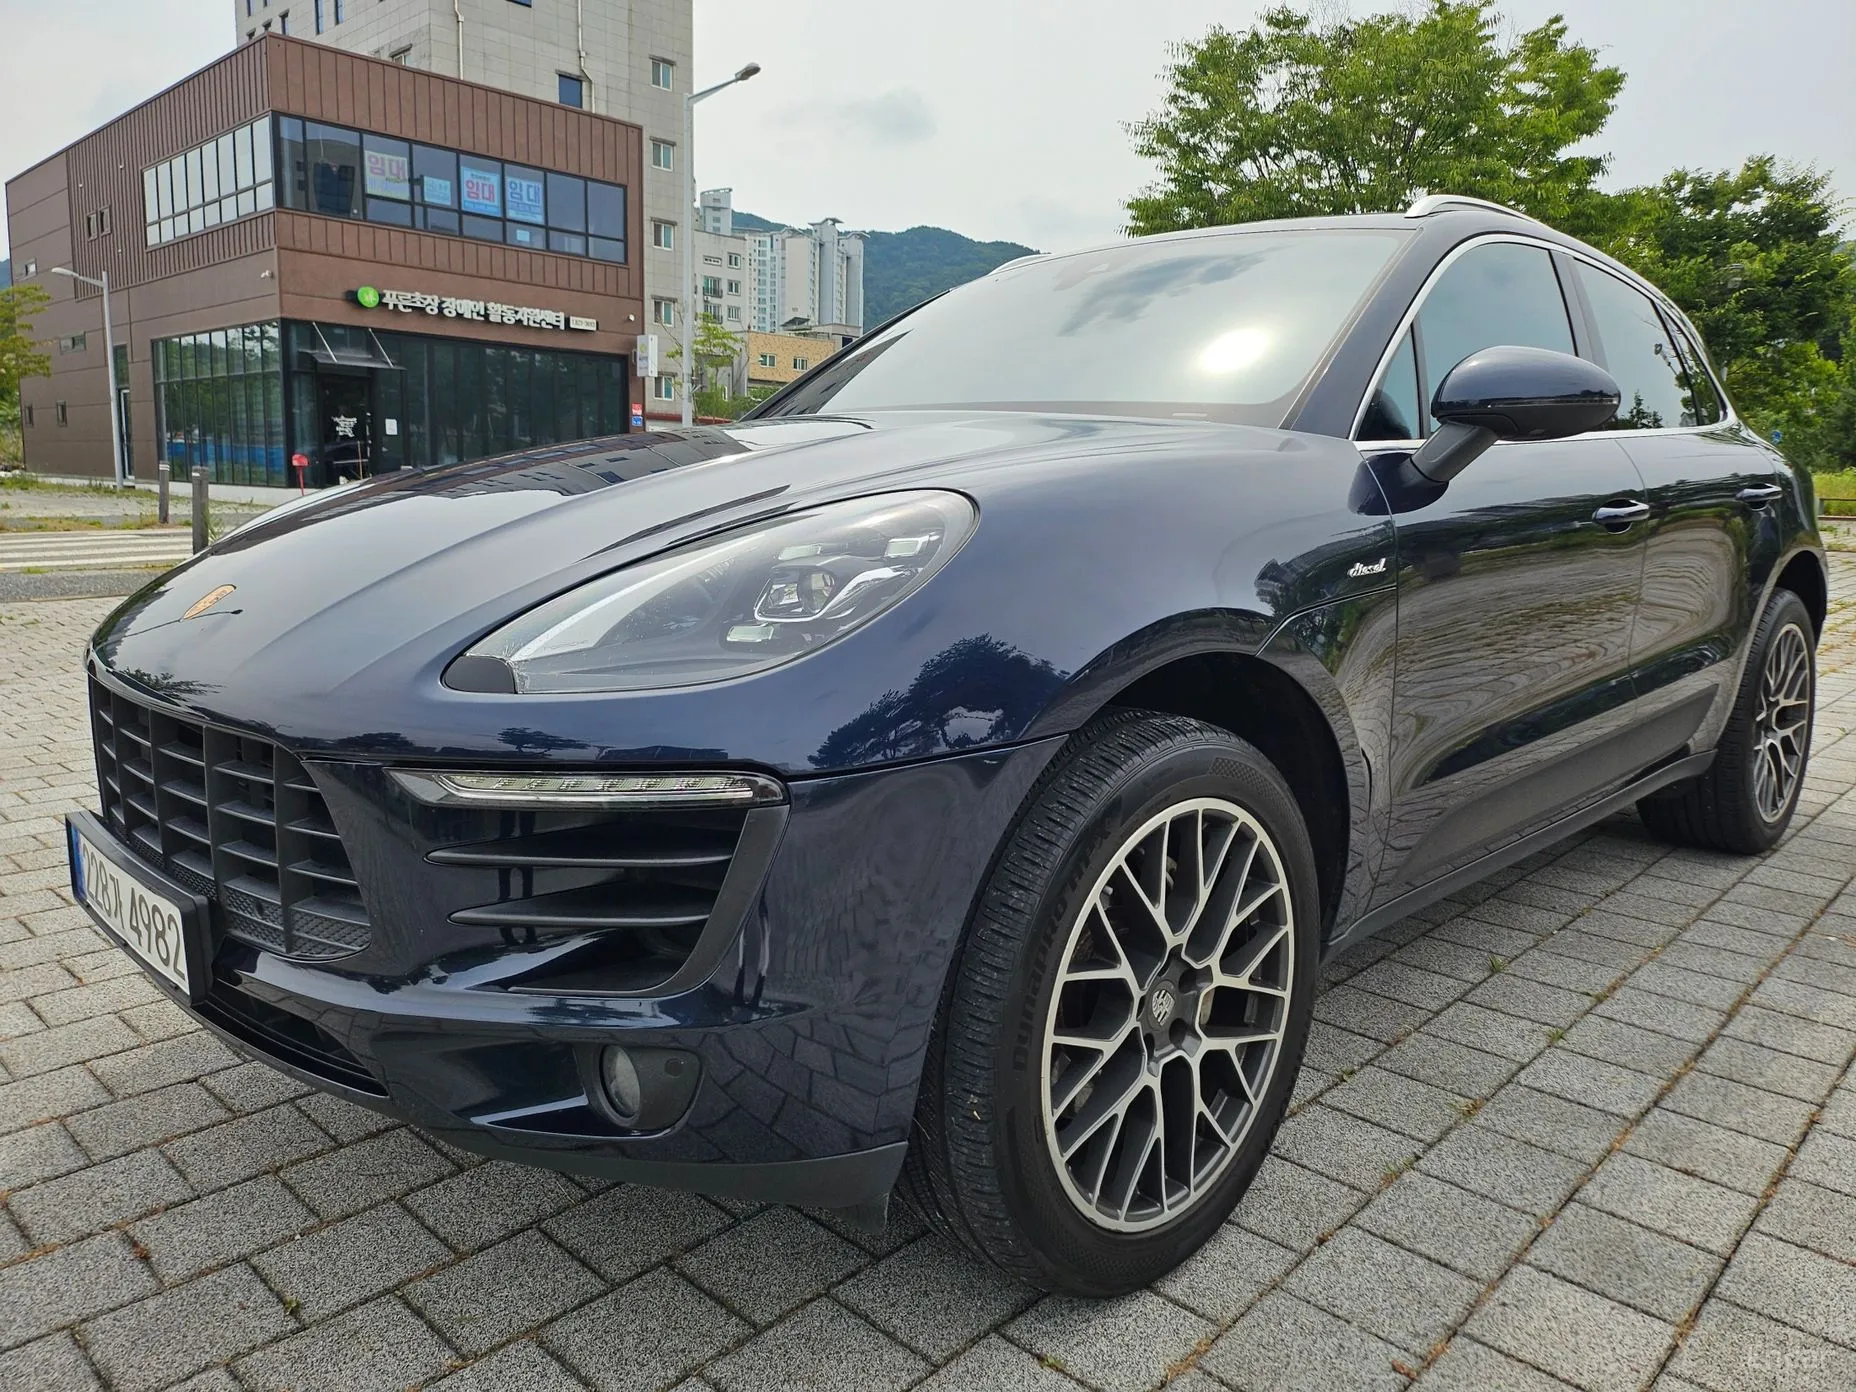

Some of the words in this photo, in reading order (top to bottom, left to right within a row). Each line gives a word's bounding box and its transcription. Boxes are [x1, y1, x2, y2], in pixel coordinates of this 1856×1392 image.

[366, 154, 406, 178] 임대
[464, 180, 496, 203] 임대
[508, 181, 541, 204] 임대
[441, 297, 485, 321] 장애인
[487, 301, 565, 331] 활동지원센터
[1346, 557, 1386, 578] diesel
[82, 843, 125, 930] 228가
[129, 886, 186, 982] 4982
